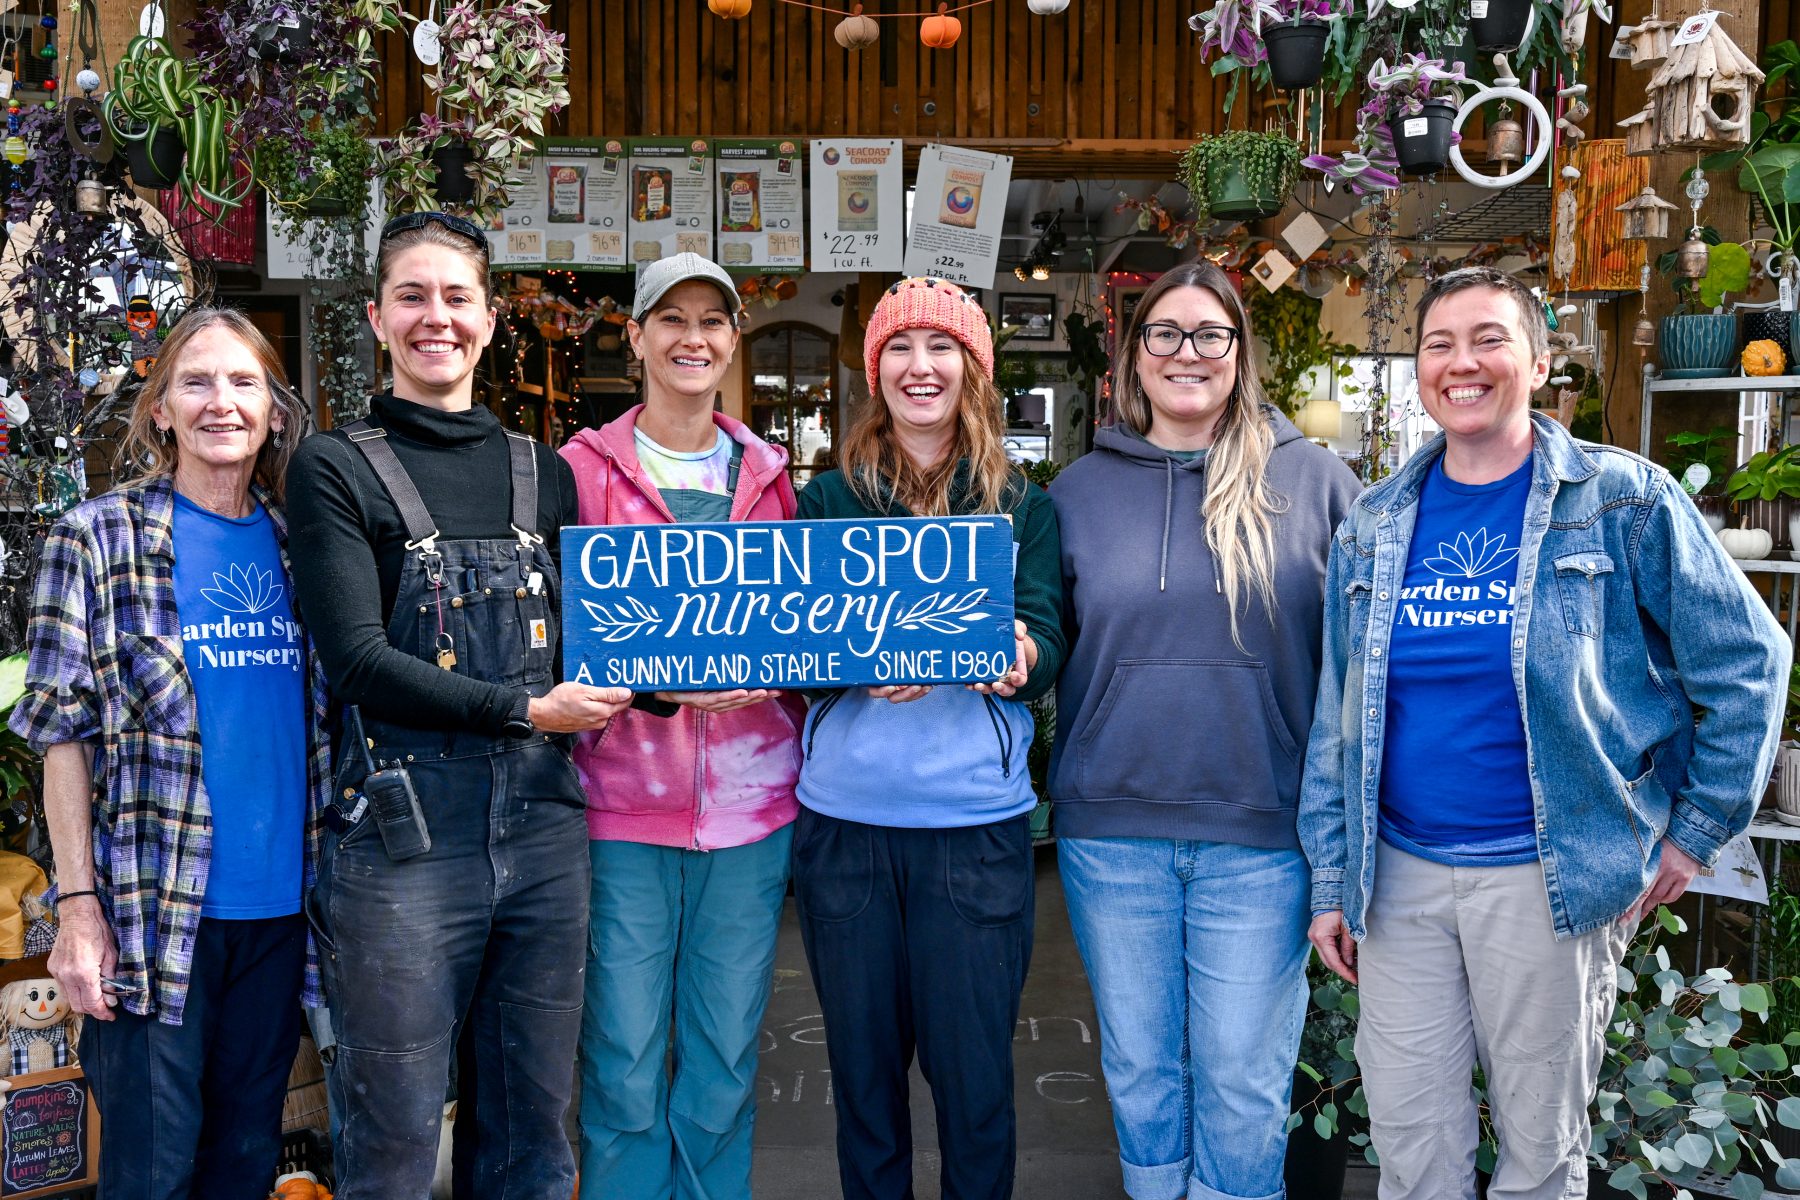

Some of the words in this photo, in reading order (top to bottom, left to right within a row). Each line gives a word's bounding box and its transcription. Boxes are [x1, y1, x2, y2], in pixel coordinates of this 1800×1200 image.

[845, 147, 891, 156] SEACOAST
[850, 156, 887, 165] COMPOST
[926, 268, 944, 278] 1.25
[580, 528, 813, 589] GARDEN
[840, 522, 994, 587] SPOT
[1400, 578, 1481, 601] arden
[664, 590, 901, 658] nursery
[1397, 604, 1514, 627] Nurser
[182, 615, 267, 641] arden
[574, 662, 594, 685] A
[606, 653, 751, 685] SUNNYLAND
[759, 652, 841, 683] STAPLE
[875, 650, 943, 681] SINCE
[952, 650, 1008, 679] 1980
[15, 1091, 67, 1113] pumpkins
[11, 1127, 46, 1142] NATURE
[47, 1121, 77, 1134] WALKS
[48, 1145, 76, 1158] LEAVES
[12, 1163, 47, 1180] LATTES
